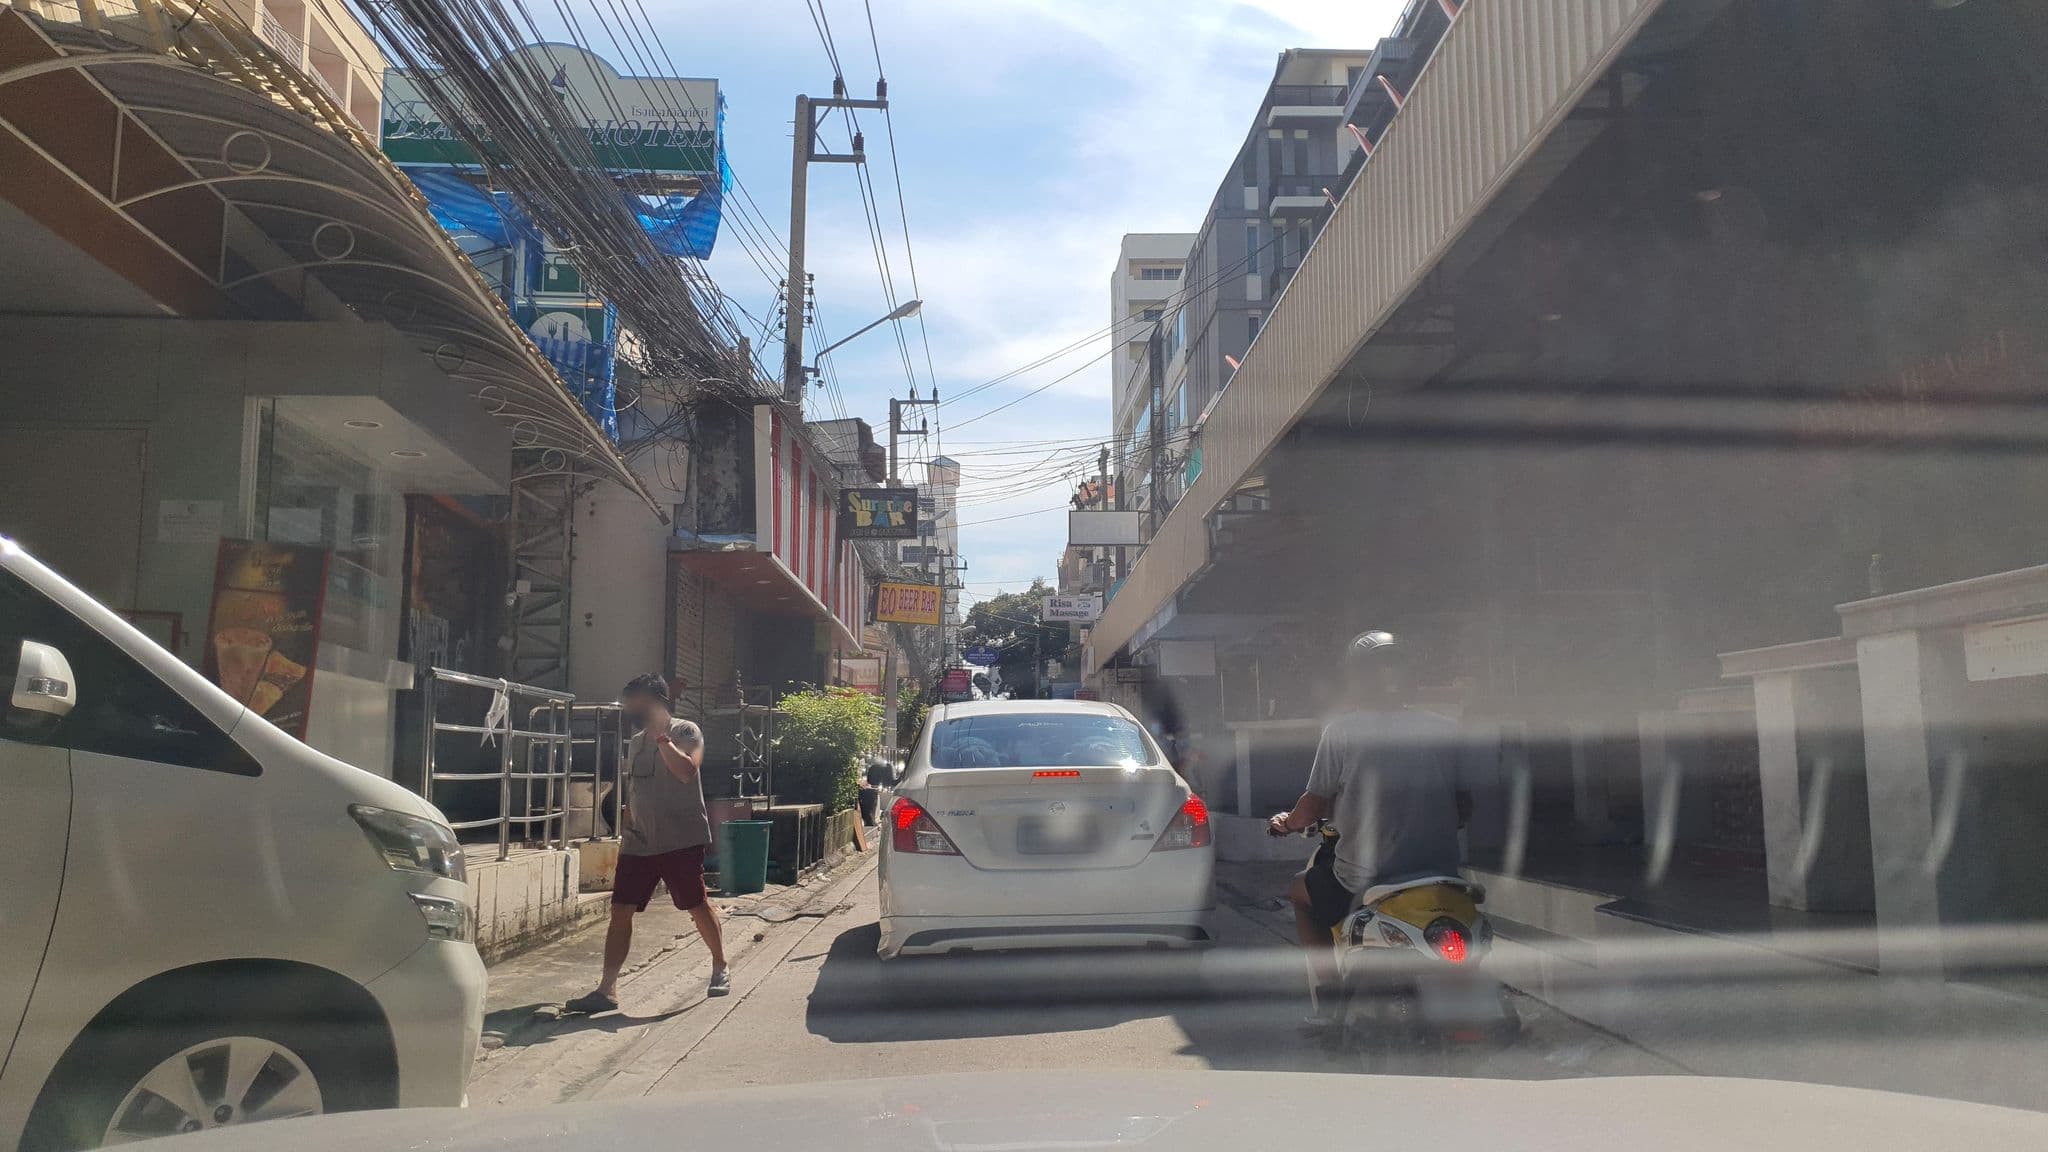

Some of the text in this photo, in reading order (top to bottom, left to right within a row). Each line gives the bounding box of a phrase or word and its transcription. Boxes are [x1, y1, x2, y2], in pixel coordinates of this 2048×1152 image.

[585, 118, 713, 148] HOTEL
[857, 511, 906, 528] BAR
[899, 588, 920, 611] BEER
[921, 590, 937, 613] BAR
[1050, 598, 1072, 607] Risa
[1050, 609, 1089, 618] Massage
